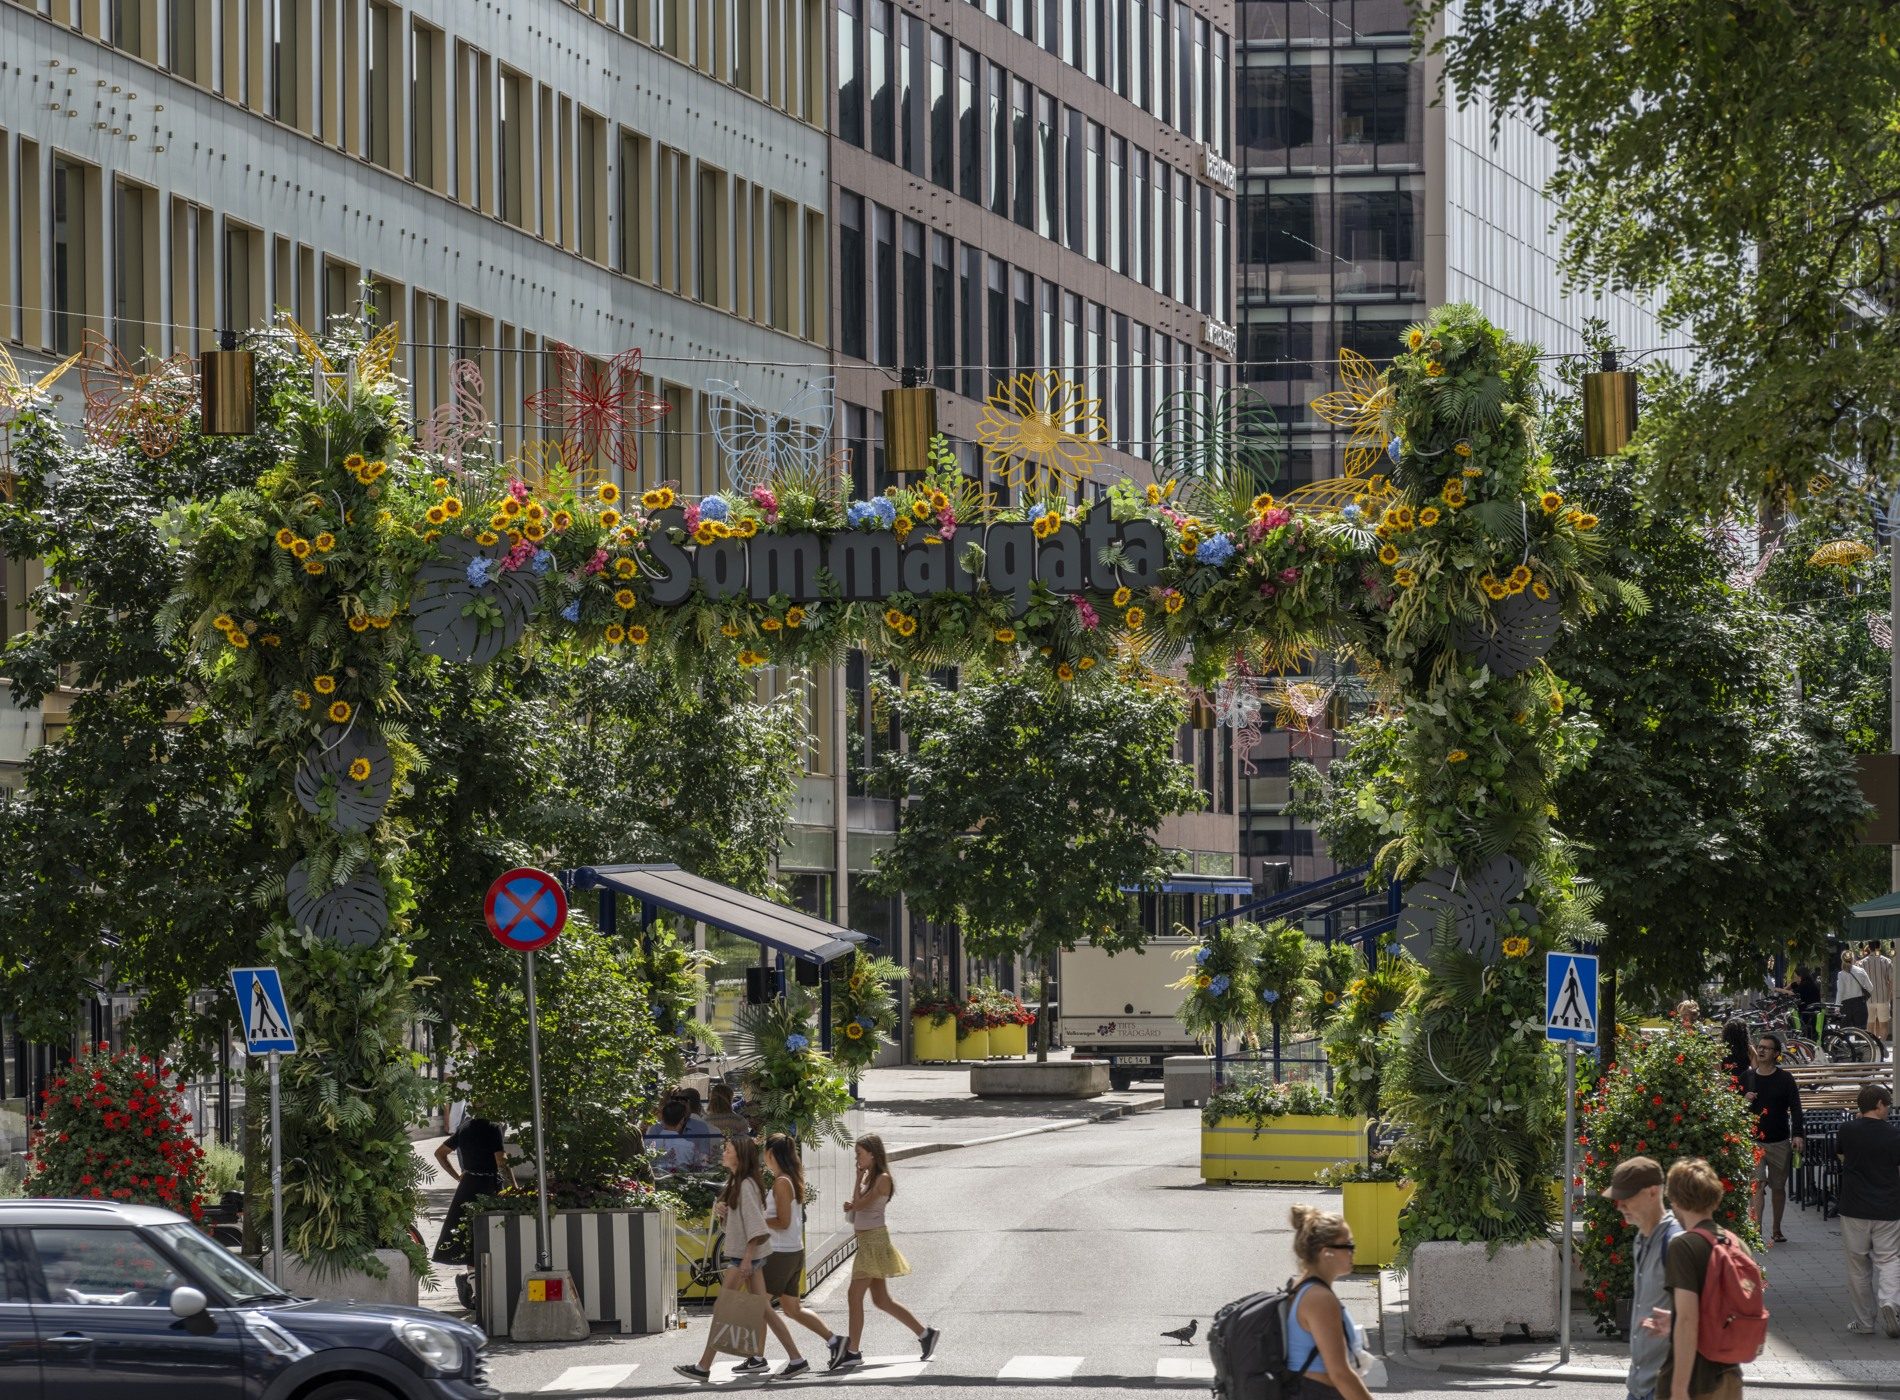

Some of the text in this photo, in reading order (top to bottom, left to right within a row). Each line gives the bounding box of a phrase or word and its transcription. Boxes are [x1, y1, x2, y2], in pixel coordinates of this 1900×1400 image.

[650, 497, 1166, 618] Sommargata
[1119, 1056, 1133, 1064] YLC
[710, 1323, 759, 1354] ZARA
